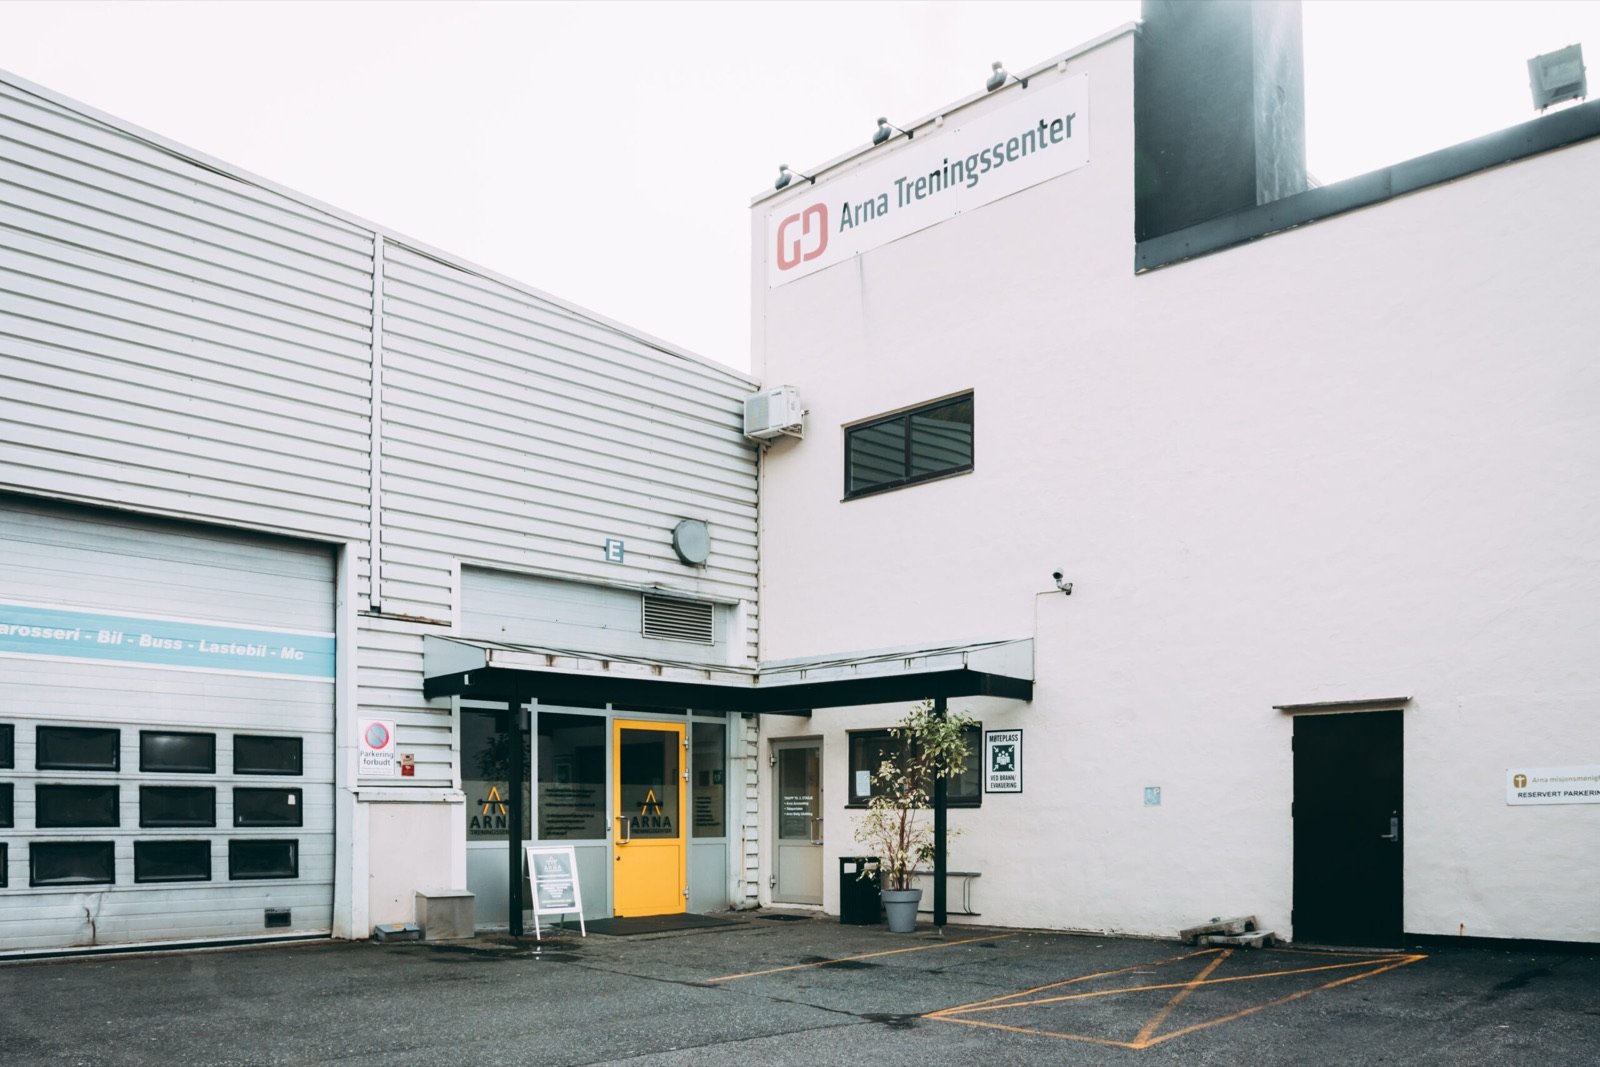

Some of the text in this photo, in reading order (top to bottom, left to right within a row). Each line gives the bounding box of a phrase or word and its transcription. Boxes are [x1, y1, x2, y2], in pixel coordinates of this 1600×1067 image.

[839, 112, 1076, 232] Arna Treningssenter
[609, 540, 621, 561] E
[97, 630, 123, 645] Bil
[139, 634, 183, 650] Buss
[198, 639, 267, 657] Lastebil
[280, 646, 304, 660] Mc
[989, 734, 1019, 743] MØTEPLASS
[360, 750, 394, 760] Parkering
[363, 758, 391, 766] forbudt
[1550, 773, 1600, 783] misjonsmenig
[1517, 790, 1561, 798] RESERVERT
[470, 815, 509, 829] ARN
[631, 815, 672, 828] ARNA
